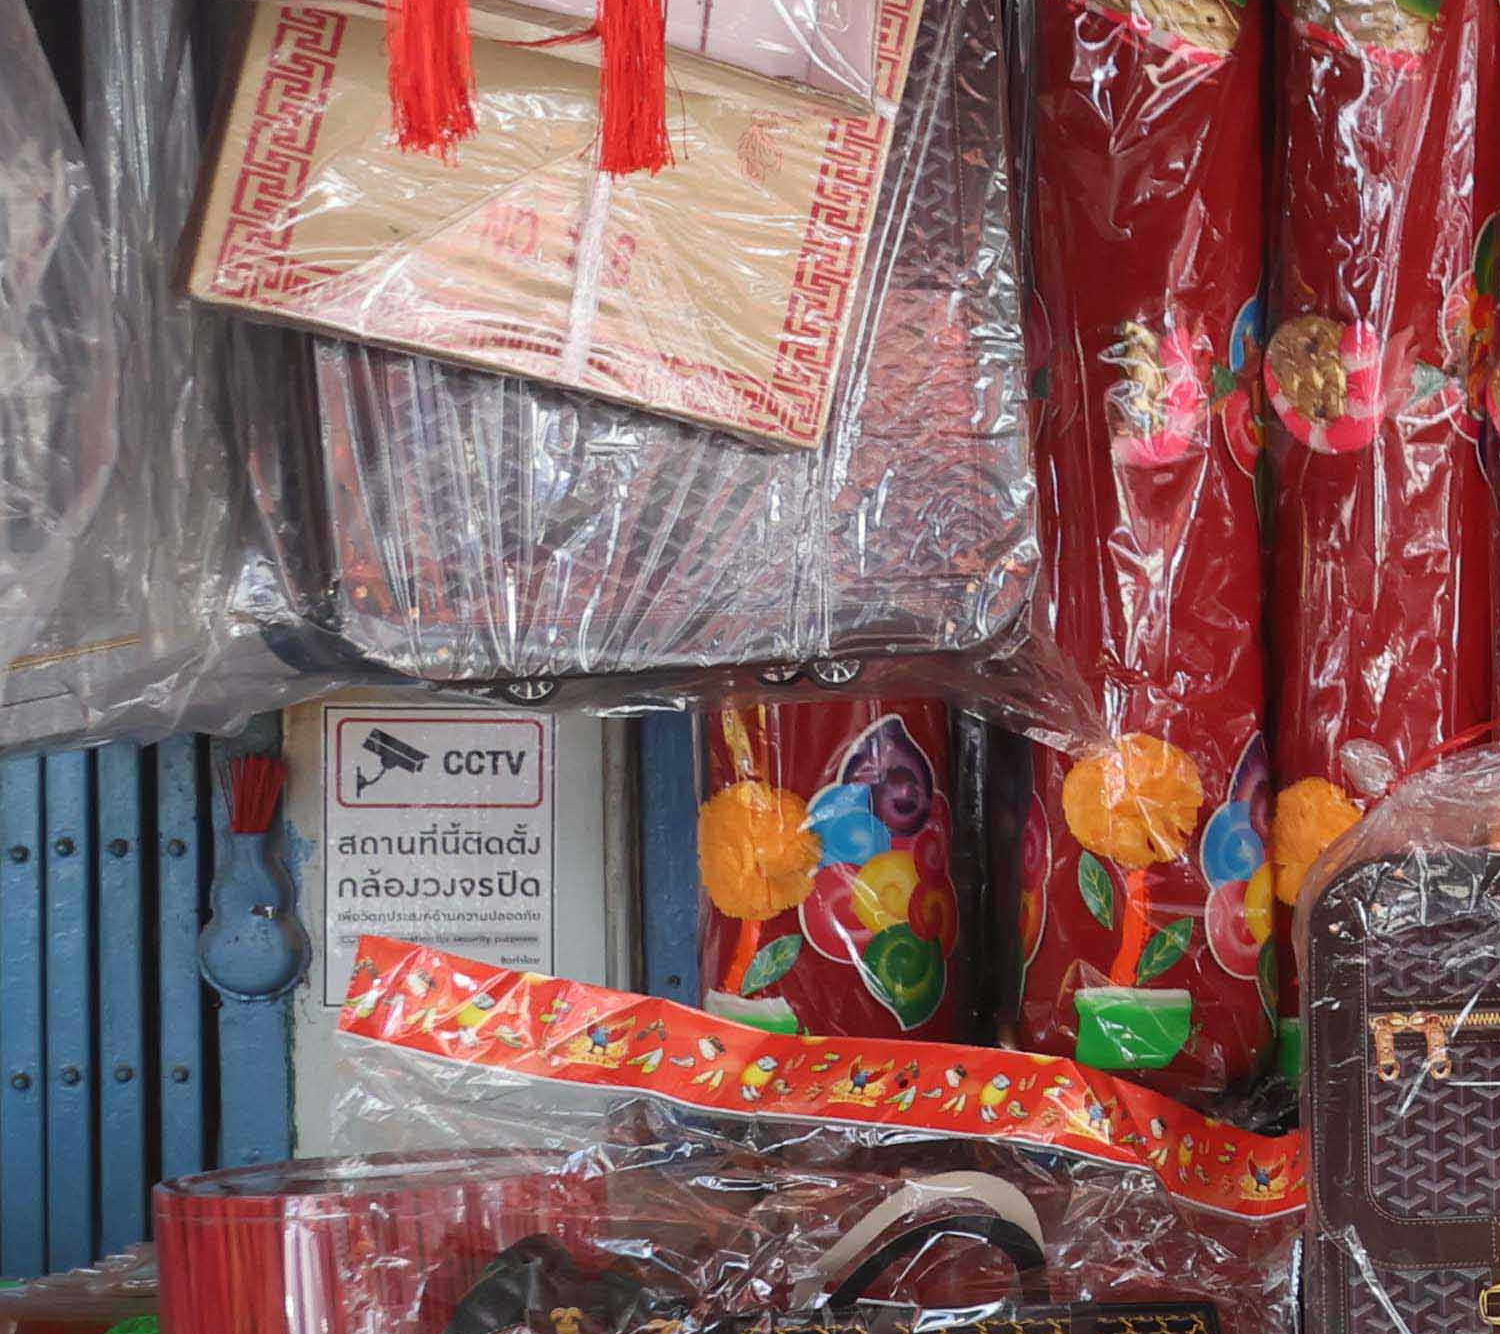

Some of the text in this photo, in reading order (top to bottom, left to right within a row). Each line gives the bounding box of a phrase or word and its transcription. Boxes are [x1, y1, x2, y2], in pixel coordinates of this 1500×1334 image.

[443, 749, 526, 776] CCTV
[338, 822, 541, 856] สถานที่นี้ติดตั้ง
[338, 868, 541, 899] กล้องวงจรปิด
